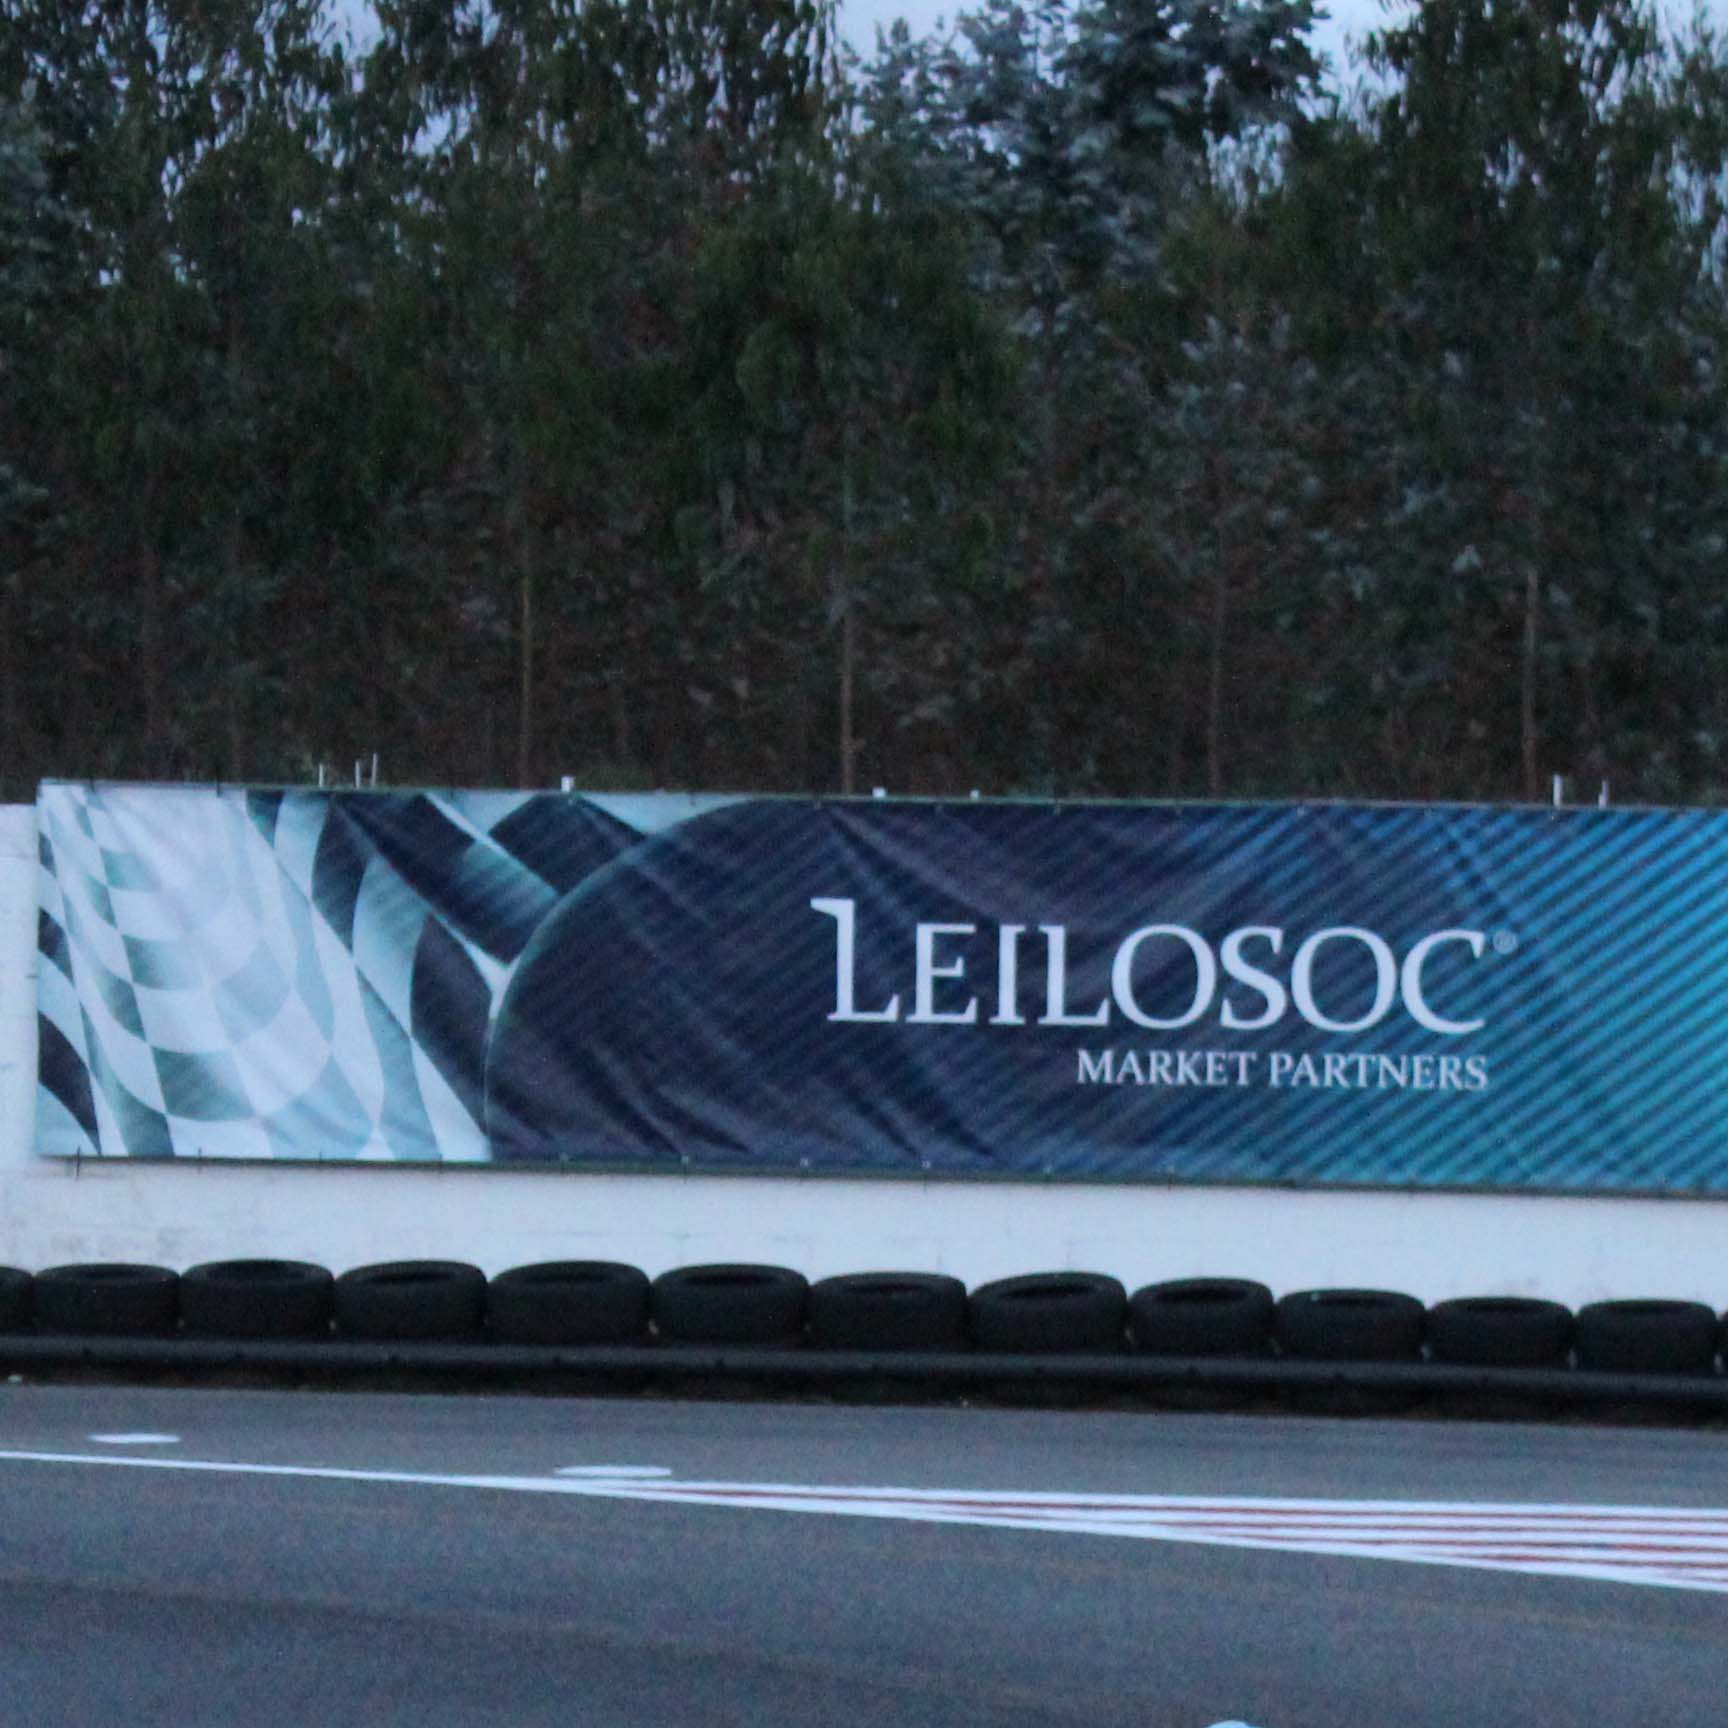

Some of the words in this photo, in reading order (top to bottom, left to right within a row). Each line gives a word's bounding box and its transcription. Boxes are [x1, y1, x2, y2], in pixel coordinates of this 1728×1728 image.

[809, 897, 1486, 1034] LEILOSOC
[1076, 1047, 1257, 1087] MARKET
[1270, 1050, 1489, 1091] PARTNERS
